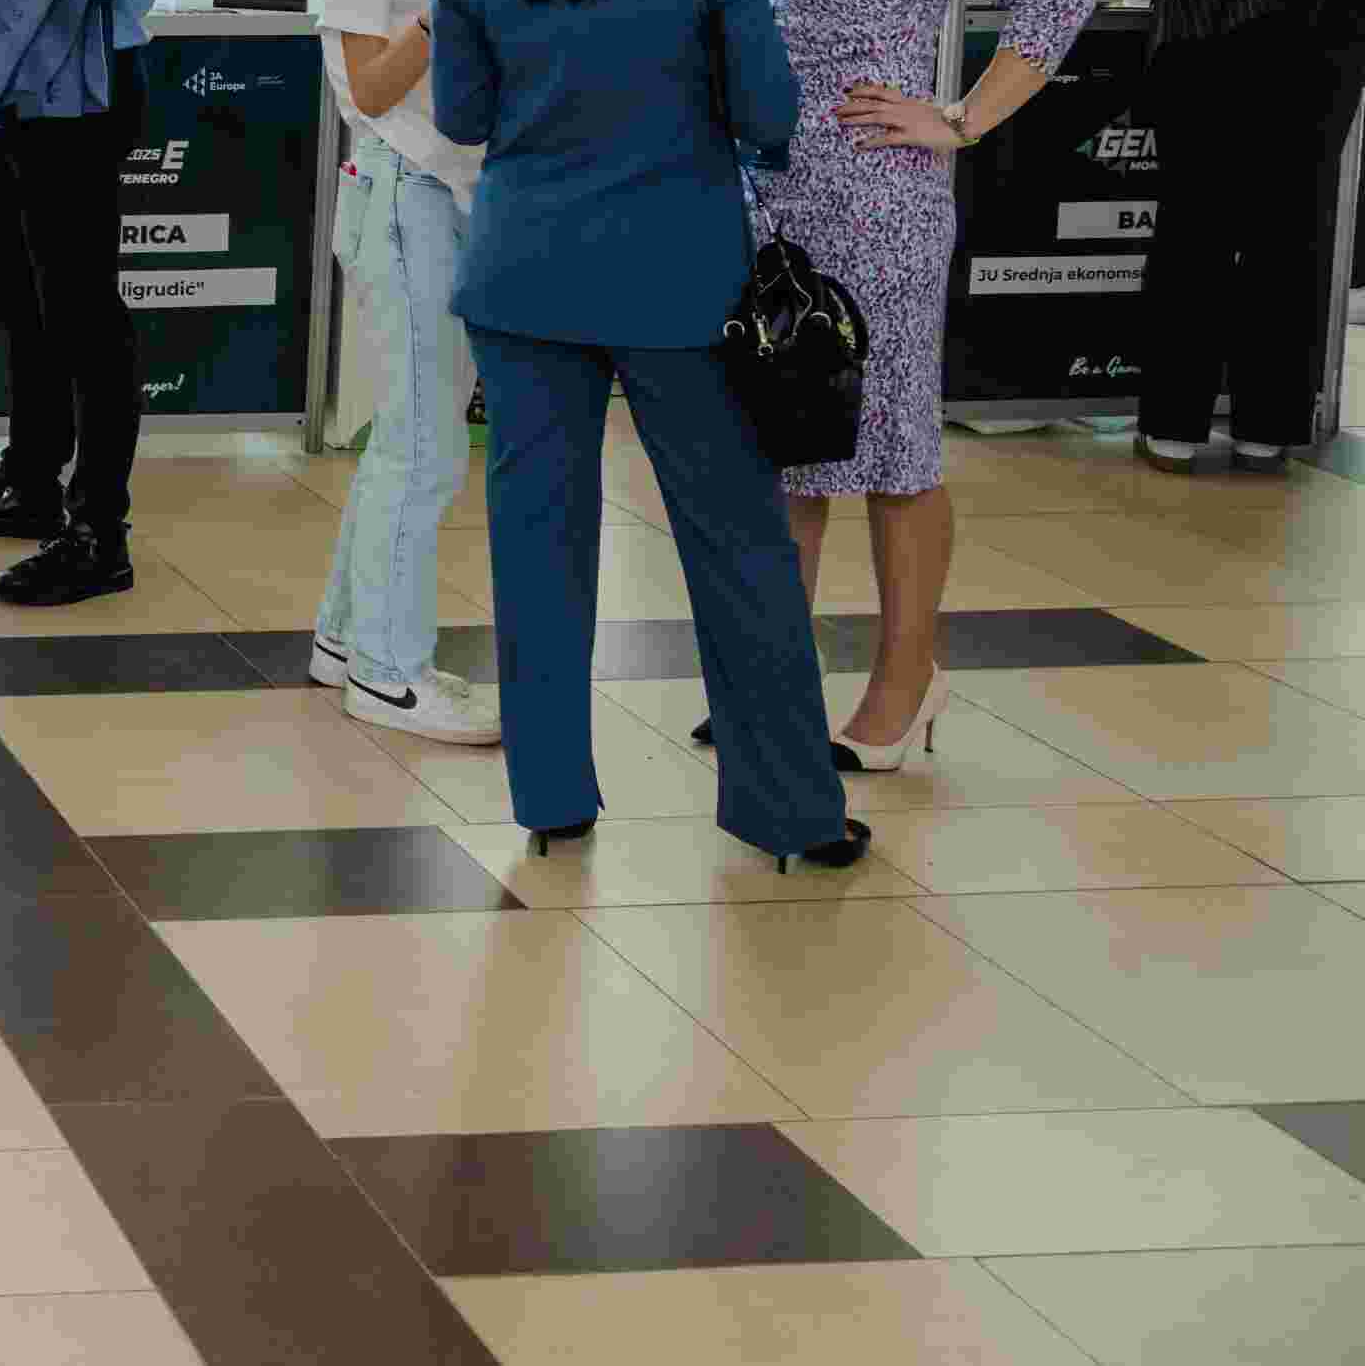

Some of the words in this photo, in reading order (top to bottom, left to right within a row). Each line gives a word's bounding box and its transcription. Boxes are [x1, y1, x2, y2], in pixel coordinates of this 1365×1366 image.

[161, 139, 190, 170] E
[122, 225, 187, 244] RICA
[978, 268, 999, 282] JU
[1002, 266, 1063, 284] Srednja
